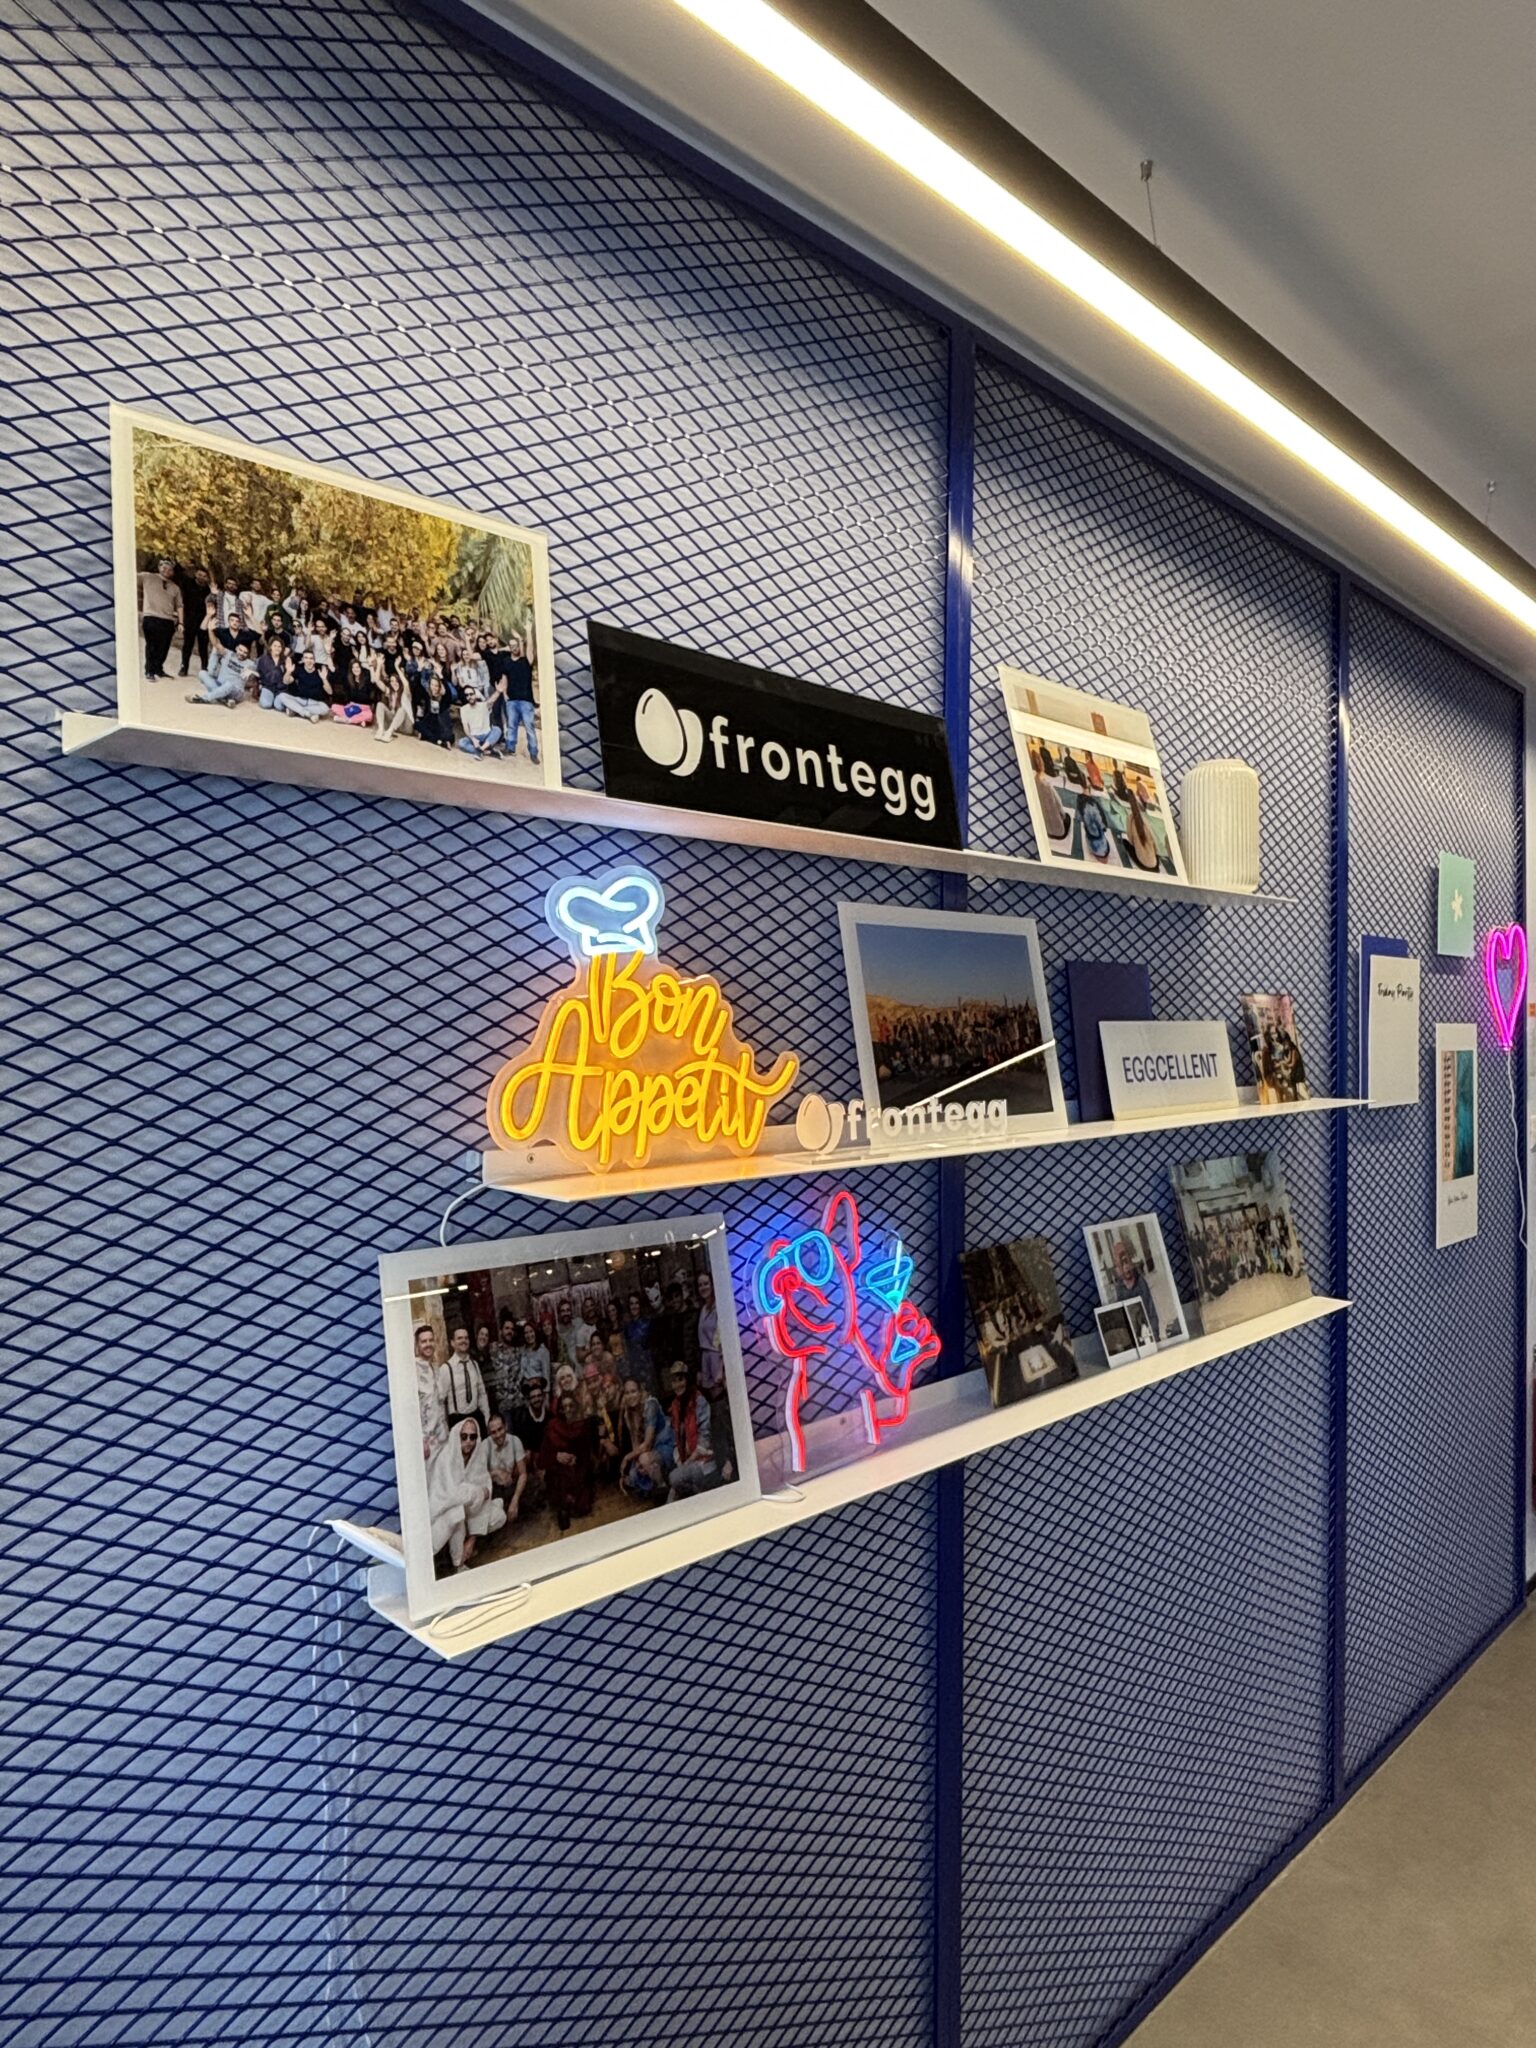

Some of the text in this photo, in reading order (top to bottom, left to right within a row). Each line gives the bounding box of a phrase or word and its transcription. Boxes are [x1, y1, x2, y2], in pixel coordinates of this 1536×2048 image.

[709, 715, 937, 821] frontegg
[587, 950, 729, 1060] Bon
[1122, 1052, 1219, 1084] EGGCELLENT
[848, 1096, 1008, 1142] frontegg
